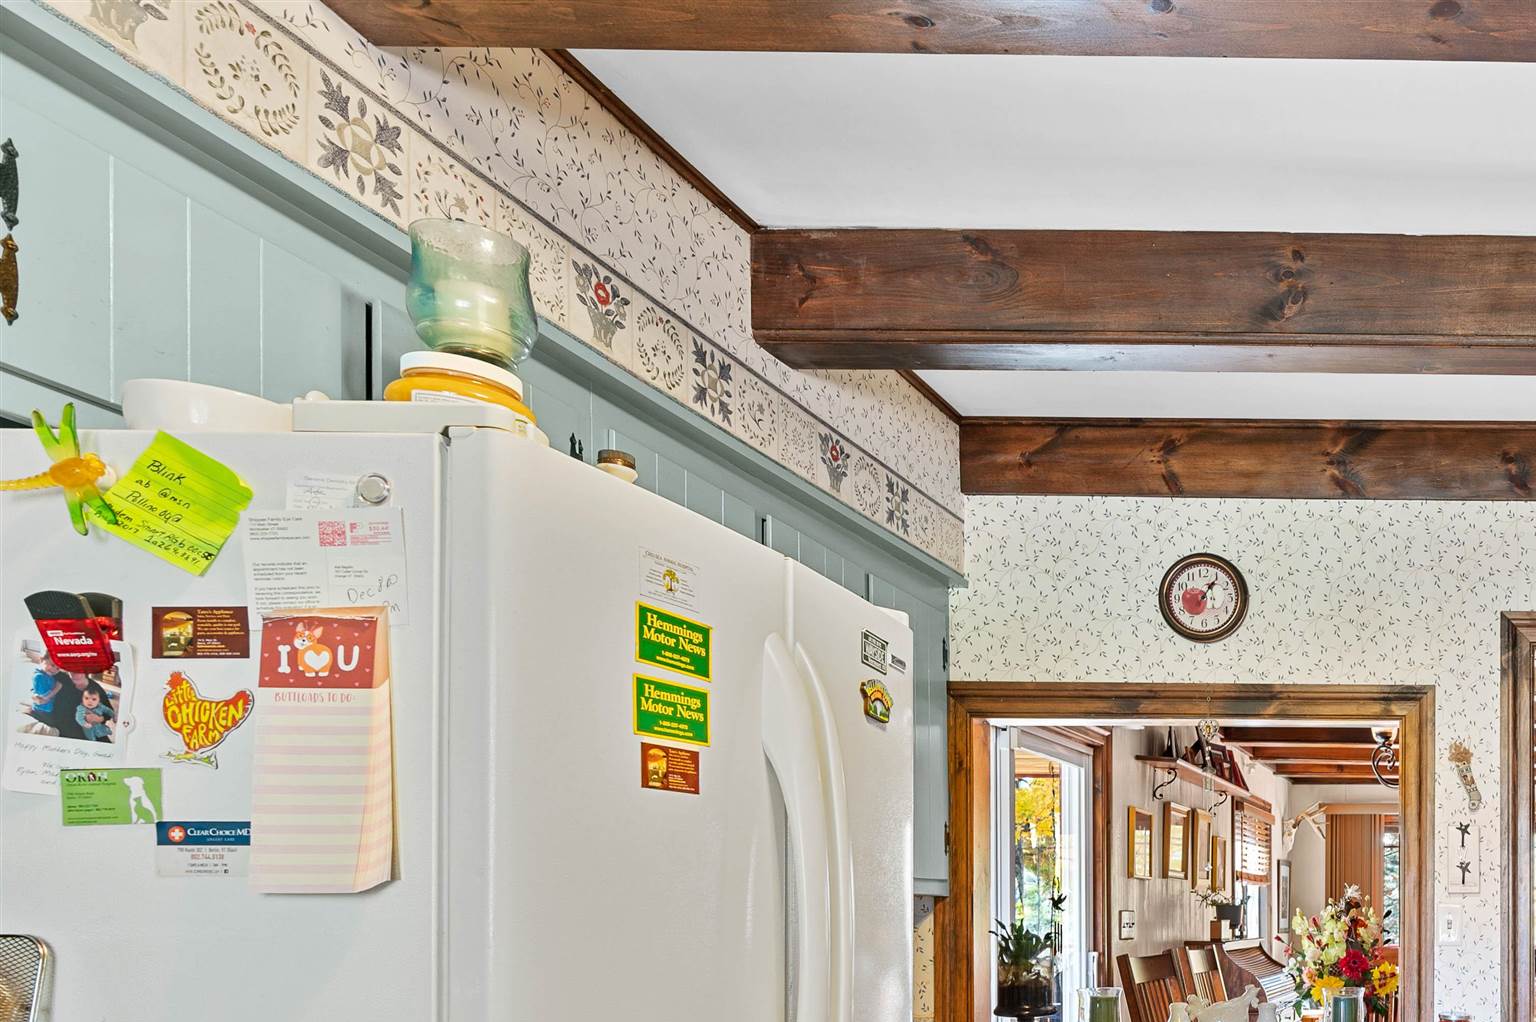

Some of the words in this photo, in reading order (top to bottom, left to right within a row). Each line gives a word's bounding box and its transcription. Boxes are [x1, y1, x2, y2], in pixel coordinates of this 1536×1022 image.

[147, 460, 186, 485] Blink
[1187, 572, 1195, 581] 11
[1198, 567, 1209, 578] 12
[347, 588, 375, 603] Dec
[1223, 581, 1229, 591] 2
[1174, 594, 1180, 603] 9
[646, 612, 704, 644] Hemmings
[1201, 618, 1208, 628] 6
[53, 636, 94, 645] Nevada
[643, 625, 676, 647] Motor
[679, 636, 706, 656] News
[337, 644, 359, 671] U
[328, 692, 337, 702] TO
[644, 683, 701, 710] Hemmings
[168, 699, 244, 733] CHICKEN
[640, 697, 674, 716] Motor
[676, 704, 704, 722] News
[182, 724, 222, 750] FARM
